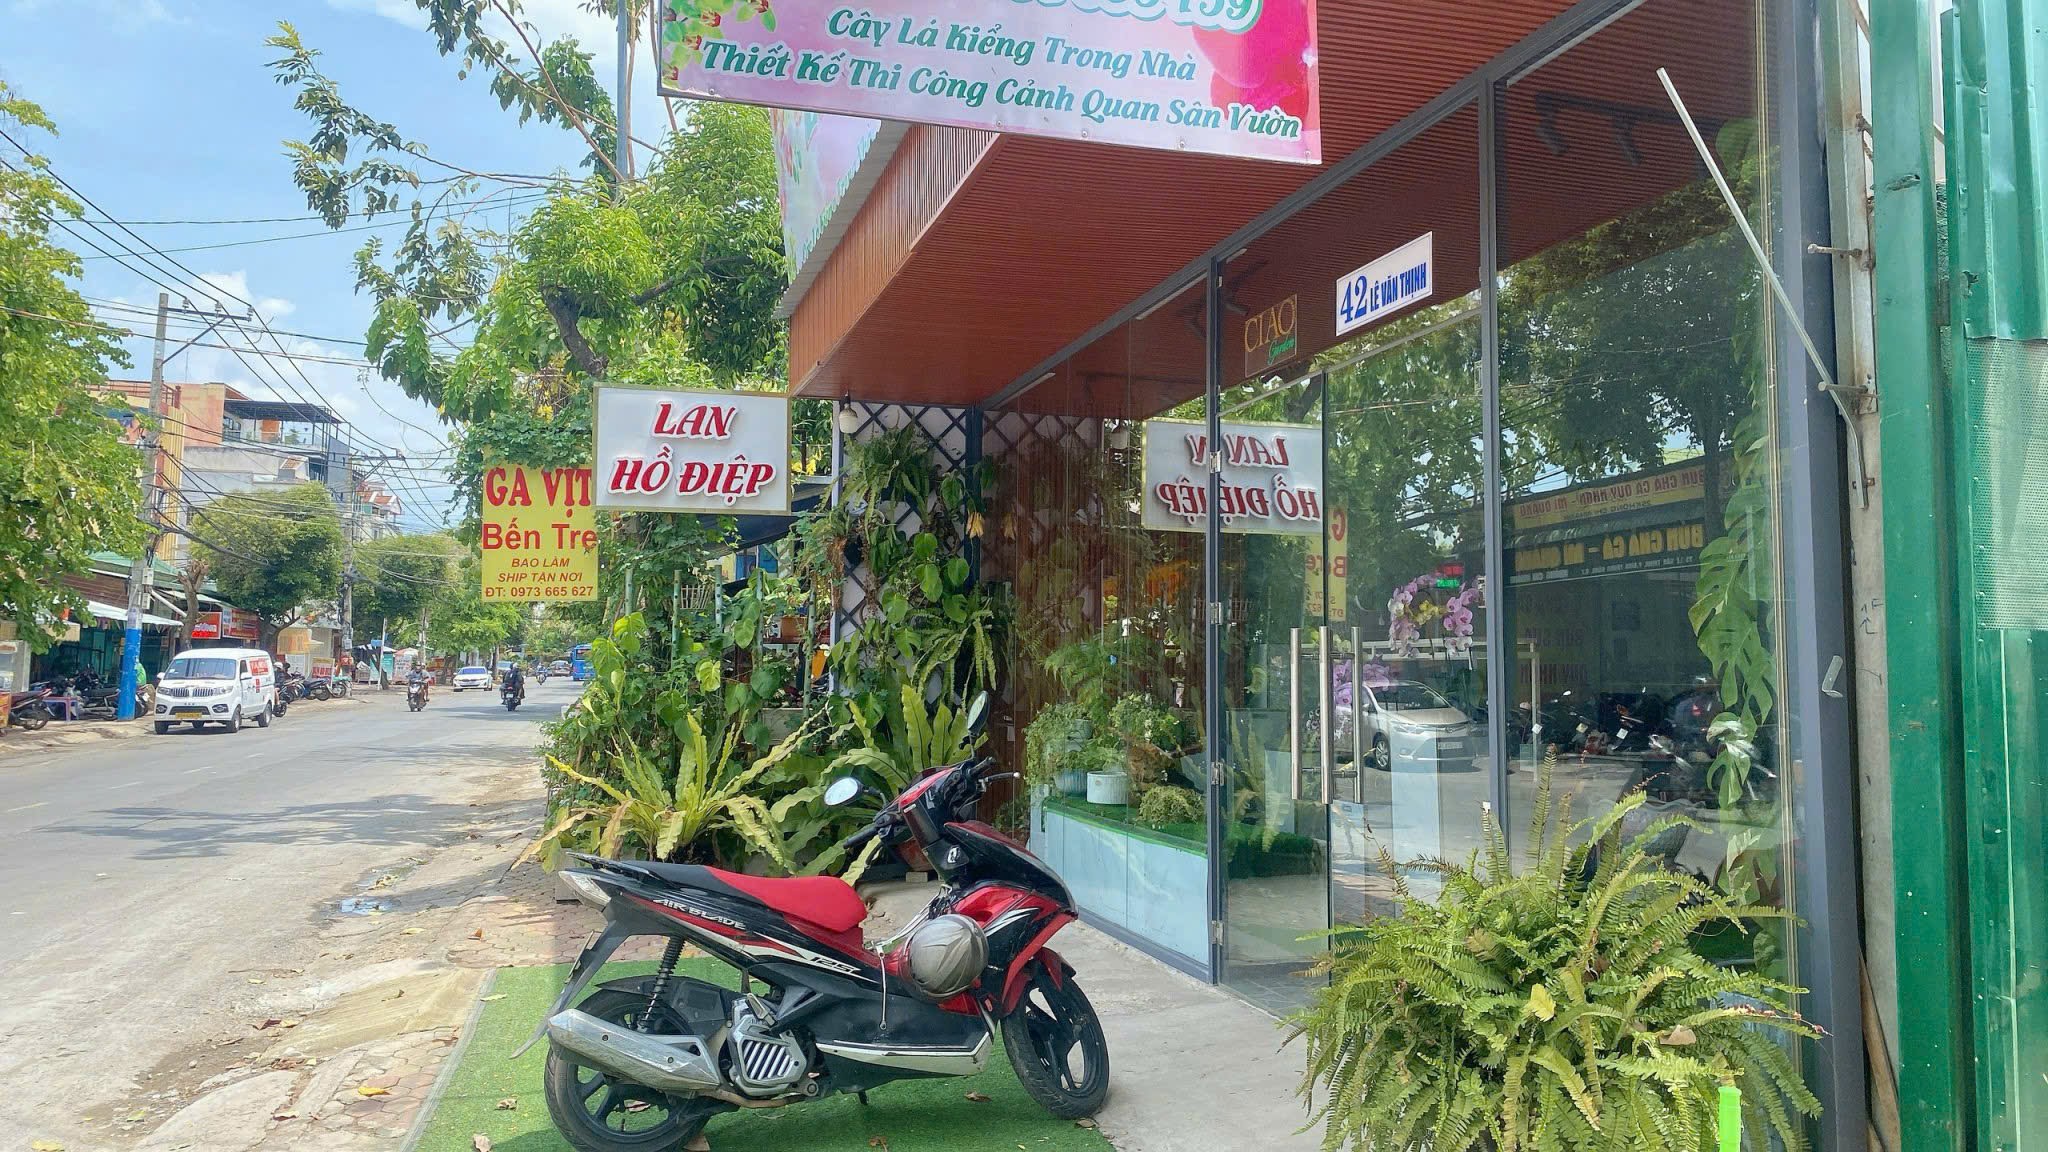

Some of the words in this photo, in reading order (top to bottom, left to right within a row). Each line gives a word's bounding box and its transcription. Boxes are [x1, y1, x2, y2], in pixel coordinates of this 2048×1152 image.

[829, 9, 891, 47] Cây
[898, 18, 939, 47] Lá
[945, 24, 1036, 66] Kiểng
[1045, 36, 1133, 79] Trong
[1138, 50, 1197, 80] Nhà
[703, 41, 791, 77] Thiết
[797, 52, 846, 83] Kế
[850, 58, 902, 90] Thi
[908, 67, 989, 107] Công
[995, 78, 1075, 111] Cảnh
[1080, 89, 1160, 124] Quan
[1166, 99, 1221, 129] Sân
[1229, 106, 1300, 138] Vườn
[1340, 276, 1368, 324] 42
[1370, 280, 1380, 313] LÊ
[1381, 275, 1398, 307] VĂN
[1399, 262, 1427, 299] THỊNH
[1245, 298, 1295, 352] CIAO
[654, 403, 736, 437] LAN
[541, 467, 593, 518] VỊT
[610, 446, 671, 493] HỒ
[679, 454, 775, 503] ĐIỆP
[483, 516, 541, 550] Bến
[551, 523, 598, 550] Tre
[497, 572, 528, 583] SHIP
[531, 571, 557, 585] TẬN
[559, 571, 583, 583] NƠI
[511, 557, 540, 568] BAO
[542, 555, 571, 568] LÀM
[485, 587, 507, 598] ĐT:
[510, 586, 541, 598] 0973
[544, 586, 568, 597] 665
[571, 586, 594, 597] 627
[688, 907, 746, 931] BLADE
